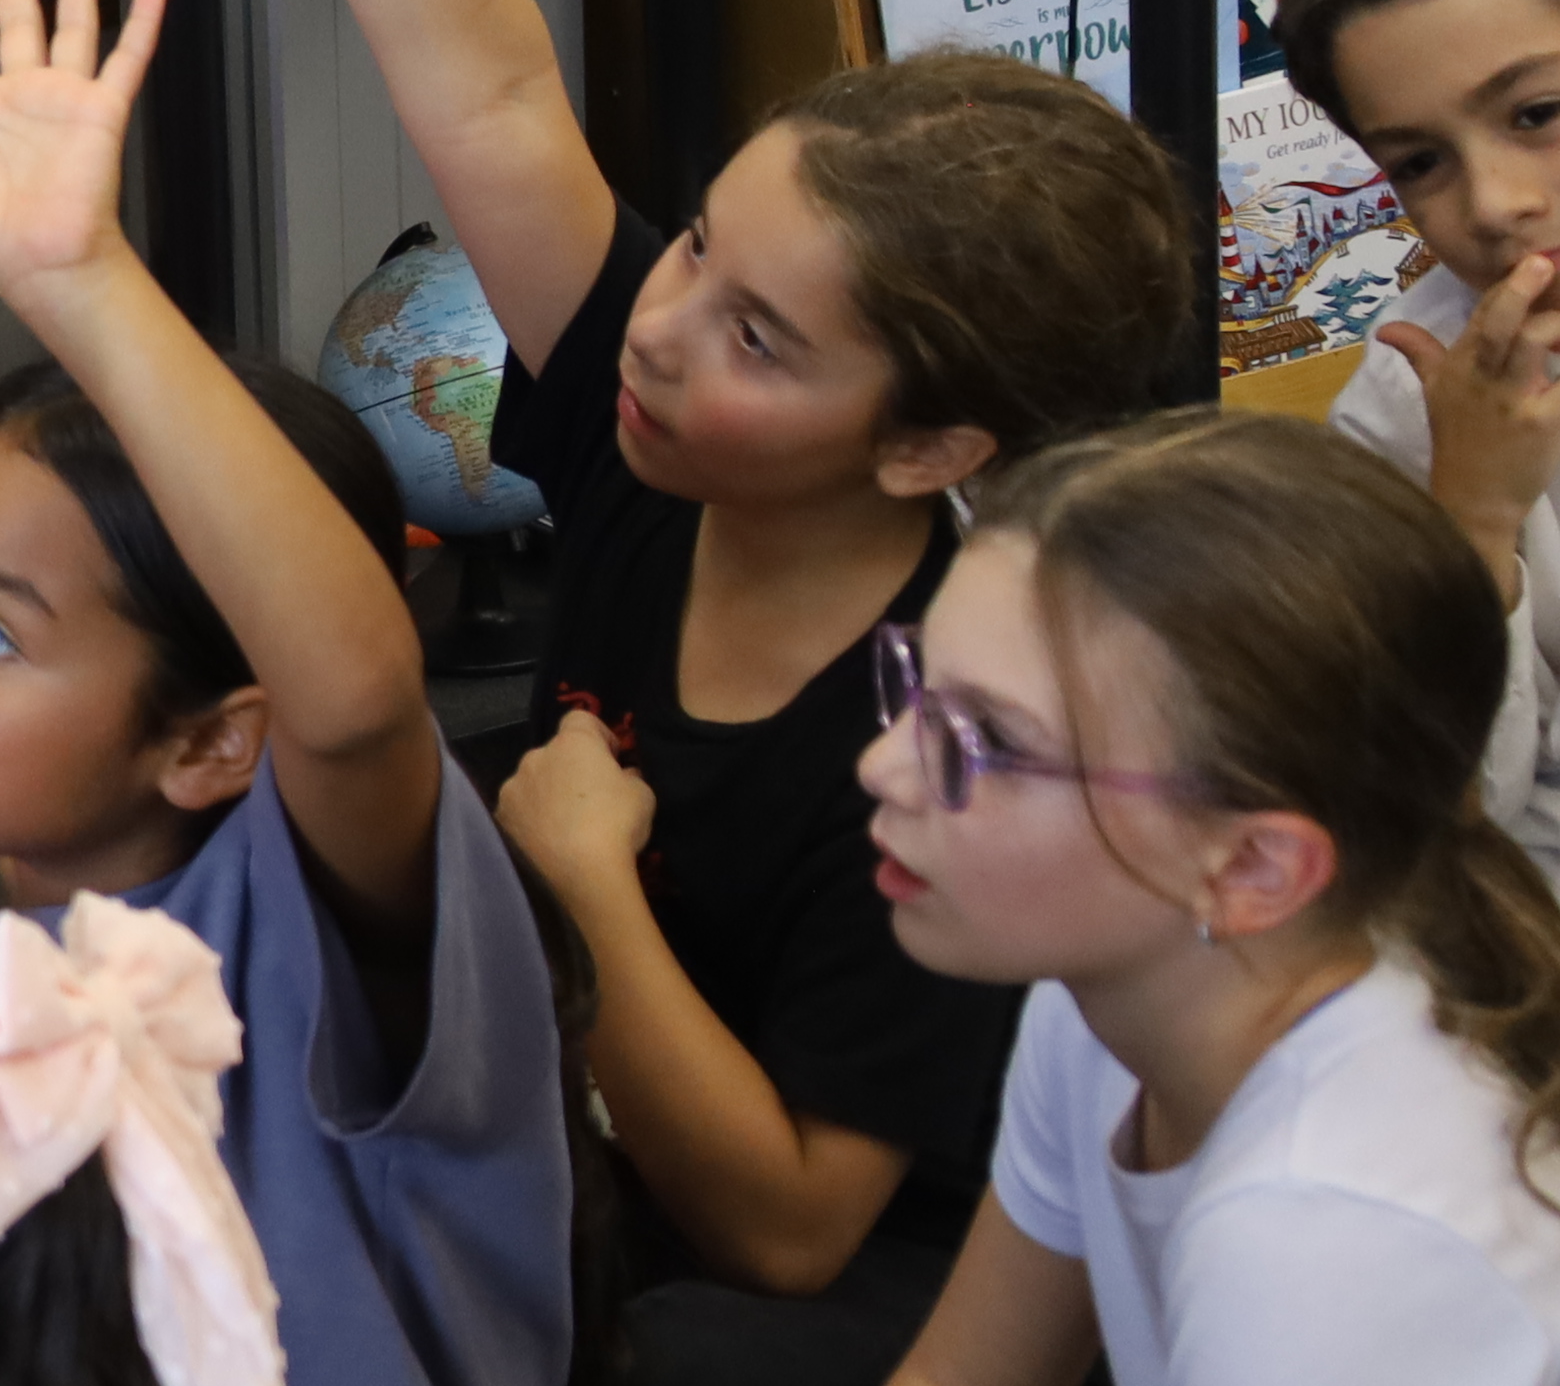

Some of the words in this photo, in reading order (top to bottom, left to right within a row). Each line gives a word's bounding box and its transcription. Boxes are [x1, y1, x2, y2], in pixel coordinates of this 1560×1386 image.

[1037, 7, 1050, 23] is
[1225, 106, 1270, 145] MY
[1266, 143, 1291, 160] Get
[1293, 129, 1332, 153] ready
[1333, 128, 1349, 146] fo
